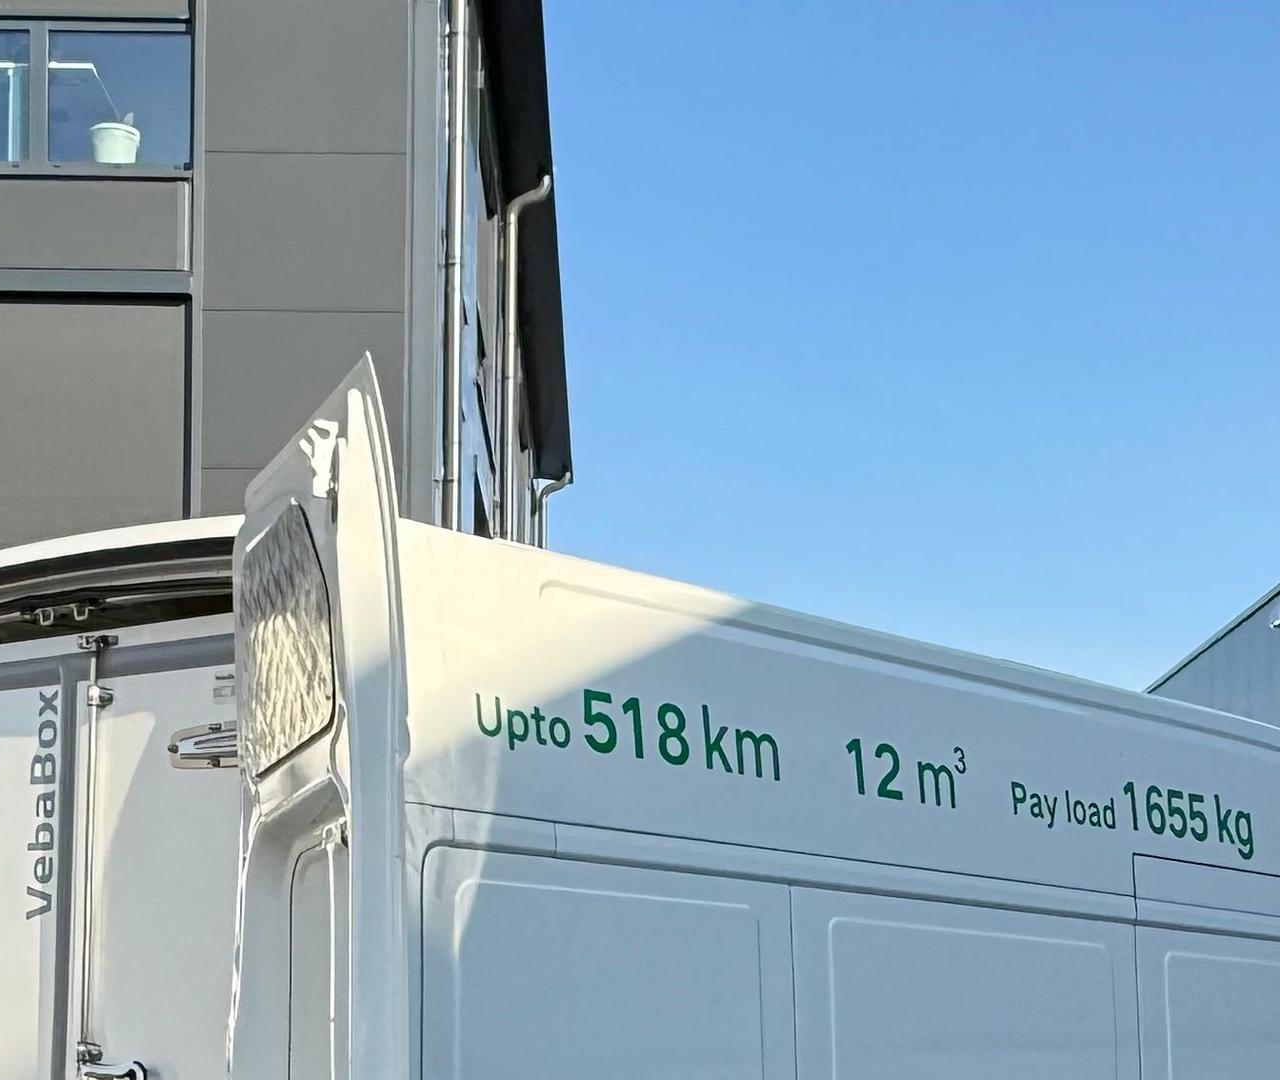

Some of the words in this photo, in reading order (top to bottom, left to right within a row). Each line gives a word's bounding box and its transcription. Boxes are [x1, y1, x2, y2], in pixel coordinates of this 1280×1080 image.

[475, 692, 571, 751] Upto
[583, 688, 690, 766] 518
[702, 704, 781, 781] km
[845, 738, 904, 801] 12
[25, 689, 59, 921] VebaBox
[1011, 781, 1058, 829] Pay
[1065, 790, 1116, 830] load
[1122, 781, 1208, 843] 1655
[1214, 794, 1255, 860] kg
